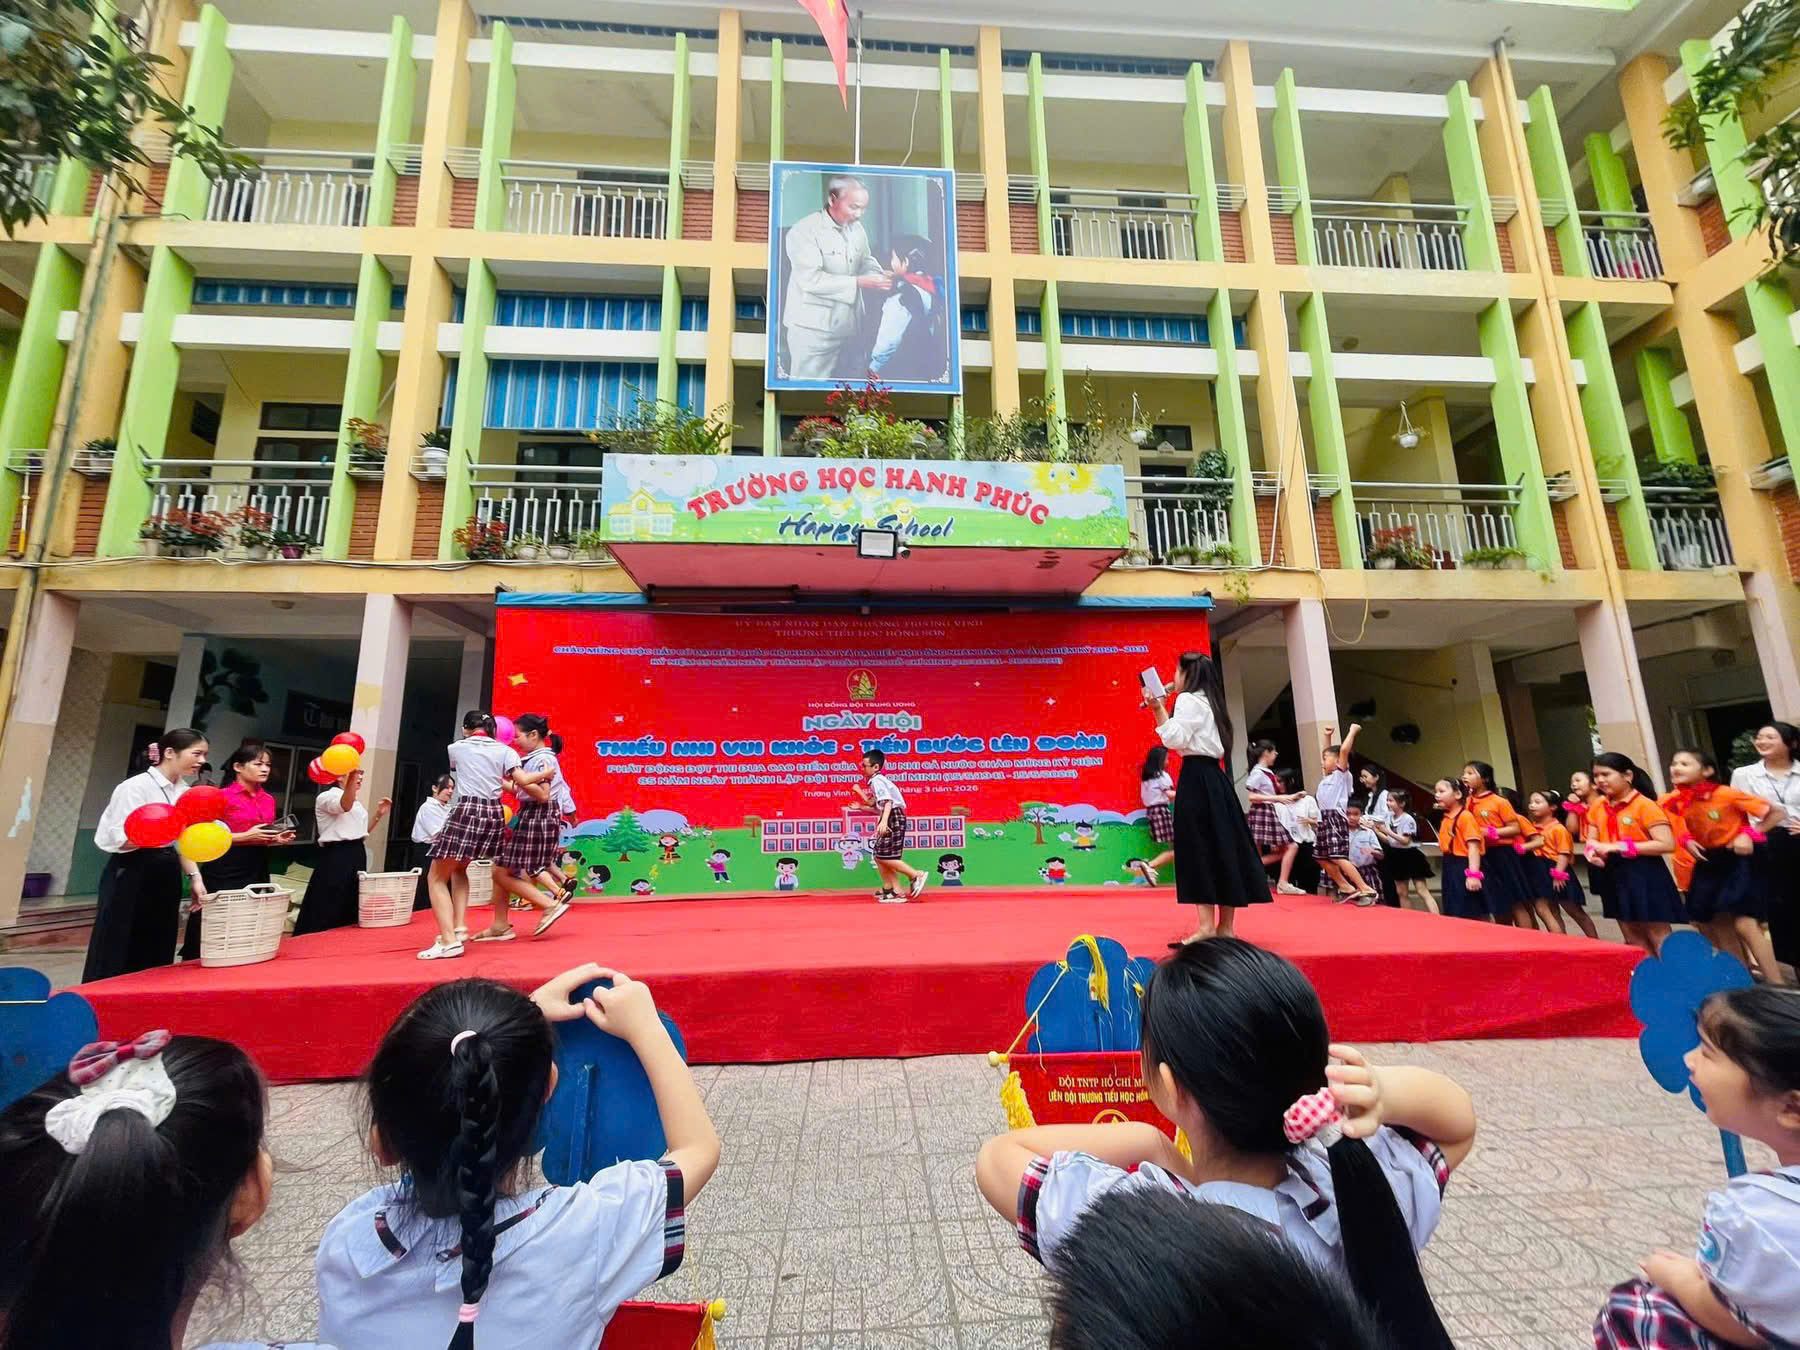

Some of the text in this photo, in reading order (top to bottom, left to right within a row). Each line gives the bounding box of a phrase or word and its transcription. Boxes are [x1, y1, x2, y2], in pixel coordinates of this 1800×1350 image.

[687, 470, 809, 519] TRƯỜNG
[817, 467, 876, 494] HỌC
[974, 481, 1049, 525] PHÚC
[779, 512, 866, 543] Happy
[802, 709, 923, 733] NGÀY HỘI
[597, 735, 667, 757] THIẾU
[671, 740, 717, 757] NHI
[721, 740, 765, 757] VUI
[769, 735, 838, 756] KHỎE
[859, 733, 911, 755] TIẾN
[915, 734, 985, 753] BƯỚC
[989, 733, 1031, 752] LÊN
[1034, 731, 1107, 751] ĐOÀN
[607, 762, 644, 774] PHÁT
[645, 762, 684, 775] ĐỘNG
[686, 764, 712, 774] ĐỢT
[714, 763, 737, 773] THI
[739, 763, 767, 773] ĐUA
[767, 763, 795, 772] CAO
[796, 760, 829, 772] ĐIỂM
[830, 761, 858, 771] CỦA
[898, 761, 920, 770] NHI
[941, 759, 977, 770] NƯỚC
[977, 759, 1013, 769] CHÀO
[1014, 757, 1051, 768] MỪNG
[1071, 756, 1104, 767] NIỆM
[657, 775, 690, 785] NĂM
[691, 775, 729, 785] NGÀY
[729, 773, 774, 785] THÀNH
[777, 773, 803, 785] LẬP
[804, 773, 828, 784] ĐỘI
[829, 774, 864, 784] TNTP
[886, 771, 907, 781] CHÍ
[908, 772, 941, 782] MINH
[899, 785, 923, 794] háng
[924, 785, 931, 793] 3
[932, 785, 953, 793] năm
[1077, 1077, 1099, 1087] TNTP
[1115, 1075, 1131, 1087] CHÍ
[1134, 1077, 1144, 1087] MI
[1048, 1088, 1063, 1103] LIÊN
[1119, 1091, 1135, 1104] HỌC
[1135, 1088, 1150, 1102] HỒN
